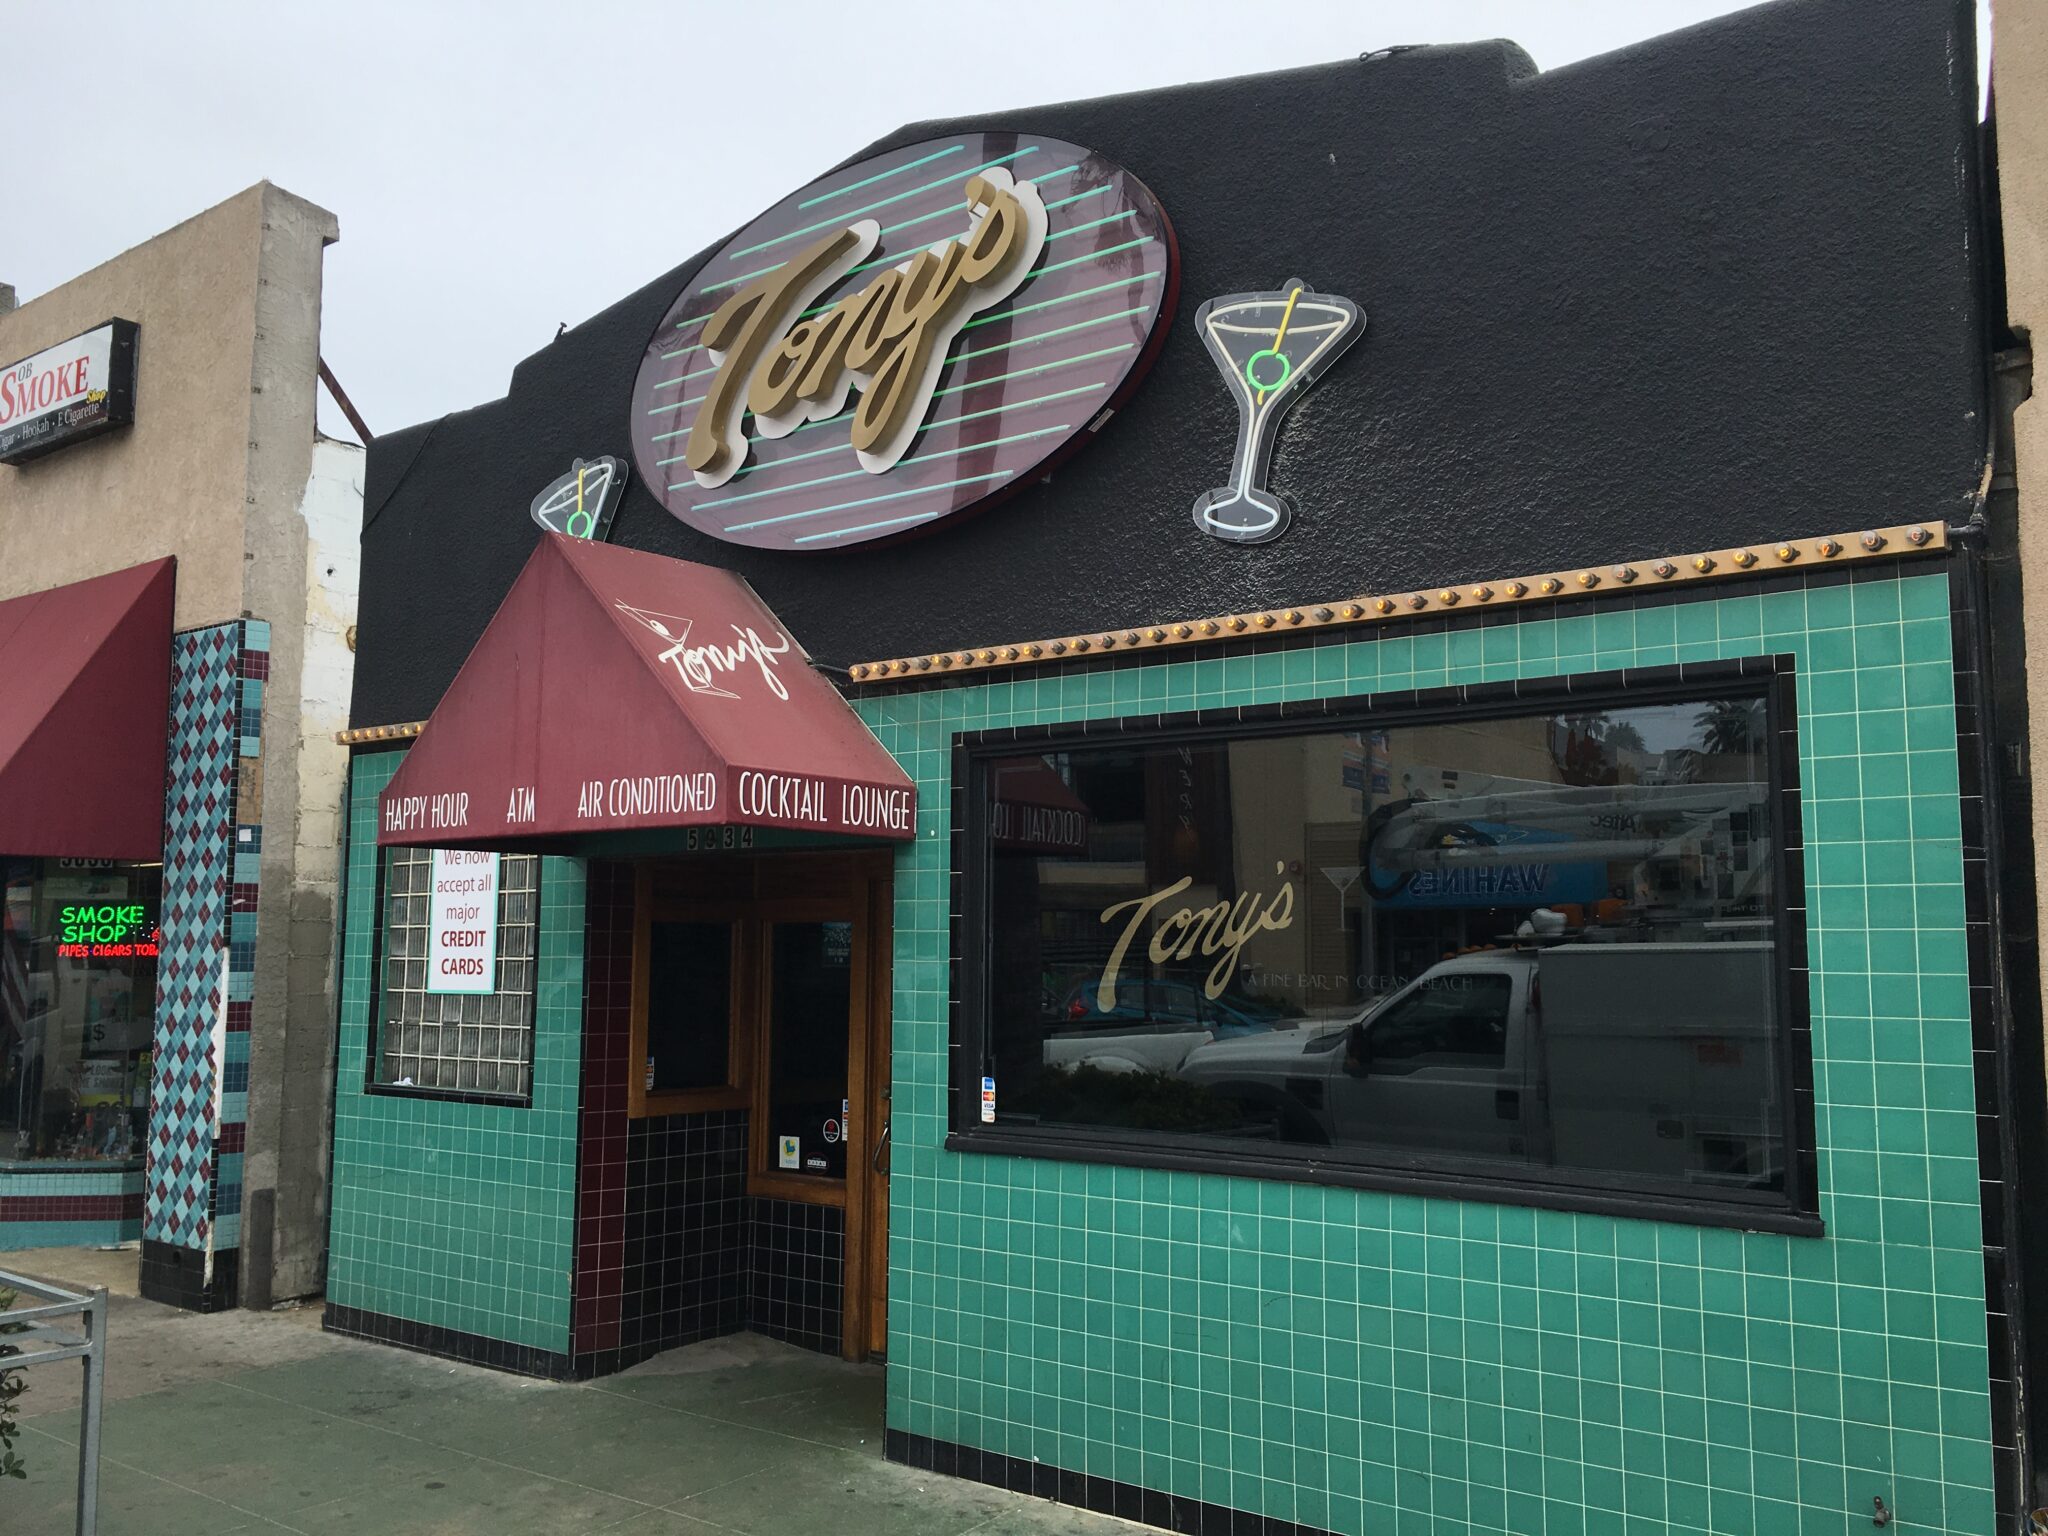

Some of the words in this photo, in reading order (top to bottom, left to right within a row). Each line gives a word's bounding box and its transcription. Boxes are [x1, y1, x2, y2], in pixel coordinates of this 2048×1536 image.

[685, 170, 1045, 488] Tony's
[18, 362, 33, 382] OB
[0, 356, 90, 425] SMOKE
[86, 388, 108, 405] Shop
[22, 419, 50, 440] Hookah
[58, 411, 64, 428] E
[64, 401, 100, 426] Cigarette
[506, 786, 536, 824] ATM
[577, 780, 604, 818] AIR
[609, 772, 716, 817] CONDITIONED
[738, 770, 828, 823] COCKTAIL
[841, 784, 910, 831] LOUNGE
[385, 795, 428, 832] HAPPY
[431, 792, 469, 828] HOUR
[444, 850, 462, 866] We
[464, 851, 490, 865] now
[437, 878, 475, 896] accept
[477, 874, 492, 891] all
[60, 905, 144, 925] SMOKE
[446, 904, 480, 924] major
[61, 925, 127, 944] SHOP
[441, 930, 486, 948] CREDIT
[1097, 860, 1294, 1014] Tony's
[58, 944, 89, 957] PIPES
[92, 944, 133, 957] CIGARS
[441, 957, 484, 975] CARDS
[1248, 975, 1257, 987] A
[1263, 974, 1293, 987] FINE
[1298, 974, 1332, 990] BAR
[1335, 975, 1350, 988] IN
[1356, 975, 1409, 989] OCEAN
[1419, 975, 1473, 990] BEACH
